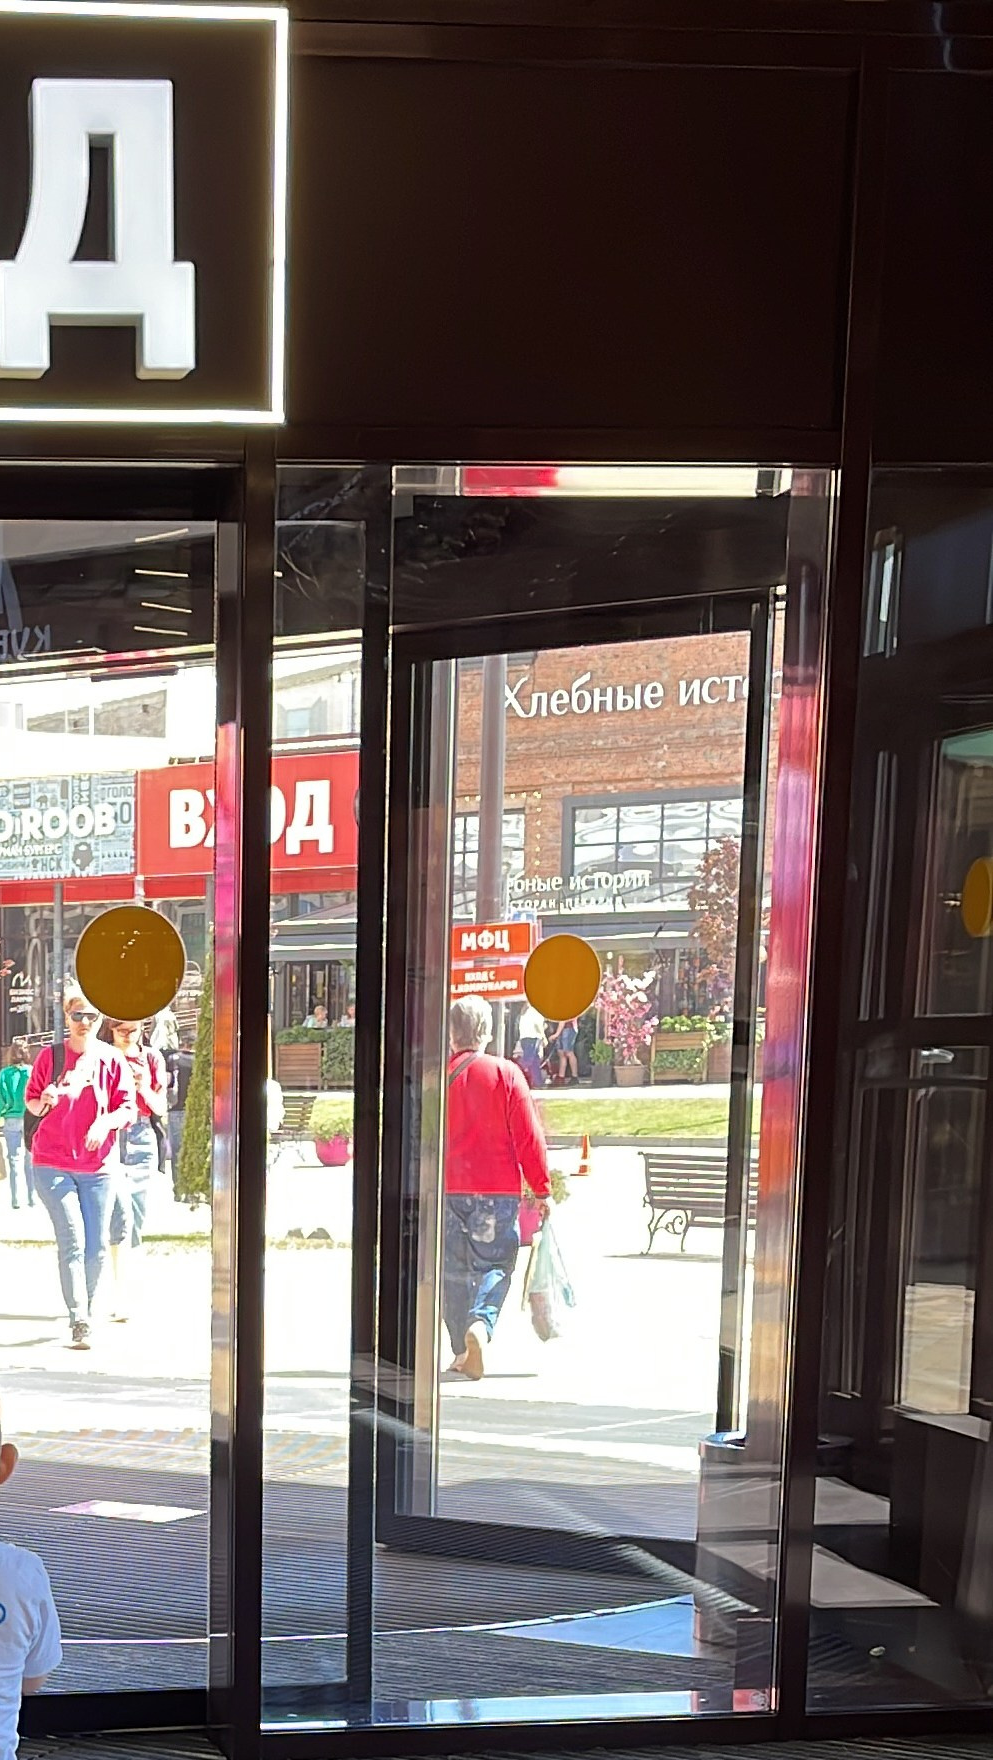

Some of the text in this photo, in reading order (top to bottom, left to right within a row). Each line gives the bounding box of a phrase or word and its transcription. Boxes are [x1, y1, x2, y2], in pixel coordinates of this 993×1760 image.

[505, 671, 783, 718] Хлебные ист
[170, 779, 334, 855] ВД
[461, 928, 510, 952] МФЦ
